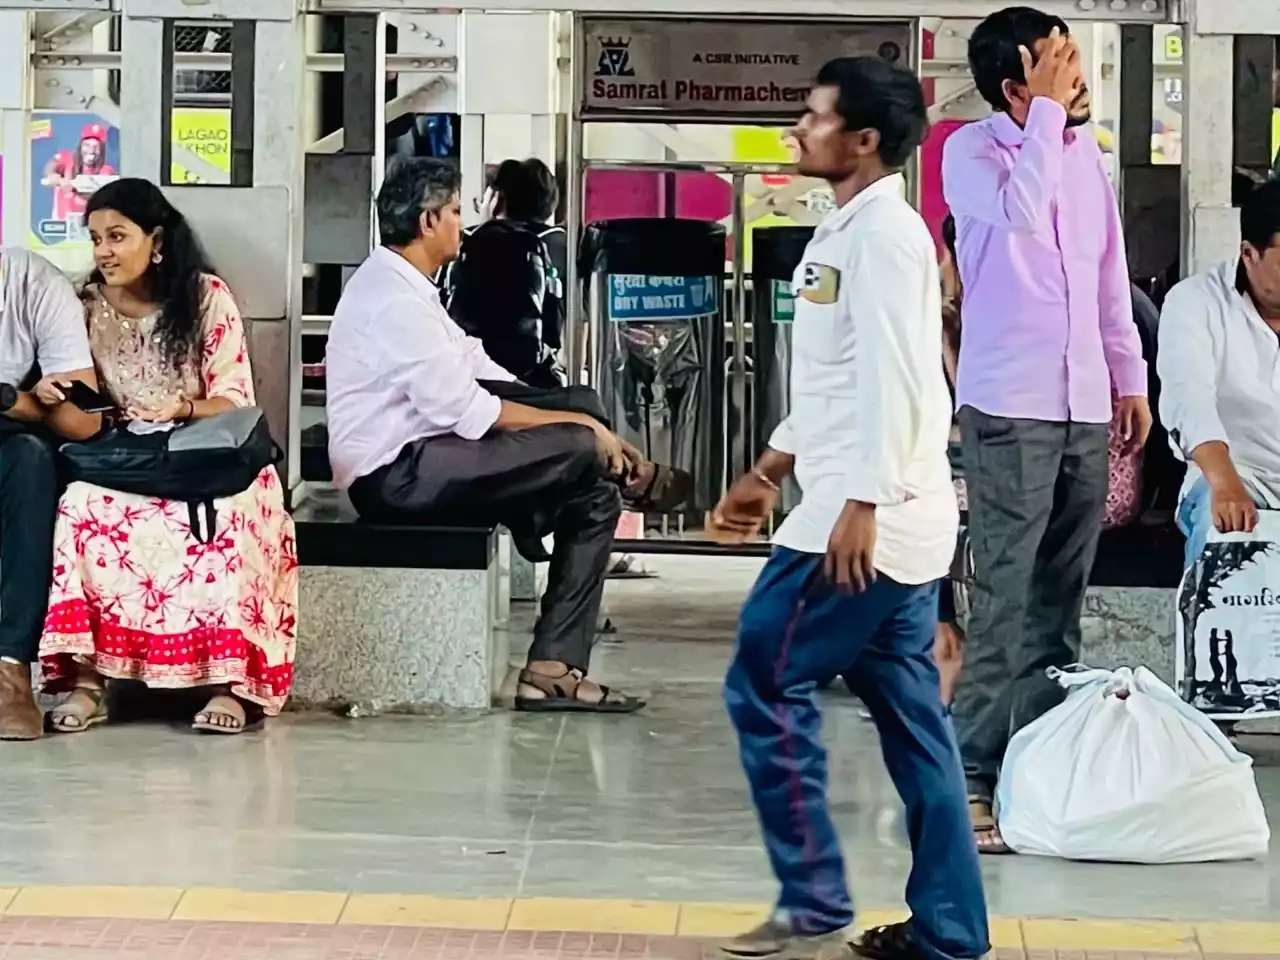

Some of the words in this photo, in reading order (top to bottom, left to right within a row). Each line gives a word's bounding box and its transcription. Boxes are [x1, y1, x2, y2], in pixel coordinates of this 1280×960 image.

[692, 53, 702, 63] A
[706, 53, 732, 64] CSR
[734, 53, 801, 65] INITIATIVE
[593, 79, 668, 100] Samrat
[614, 296, 639, 310] DRY
[642, 294, 685, 310] WASTE
